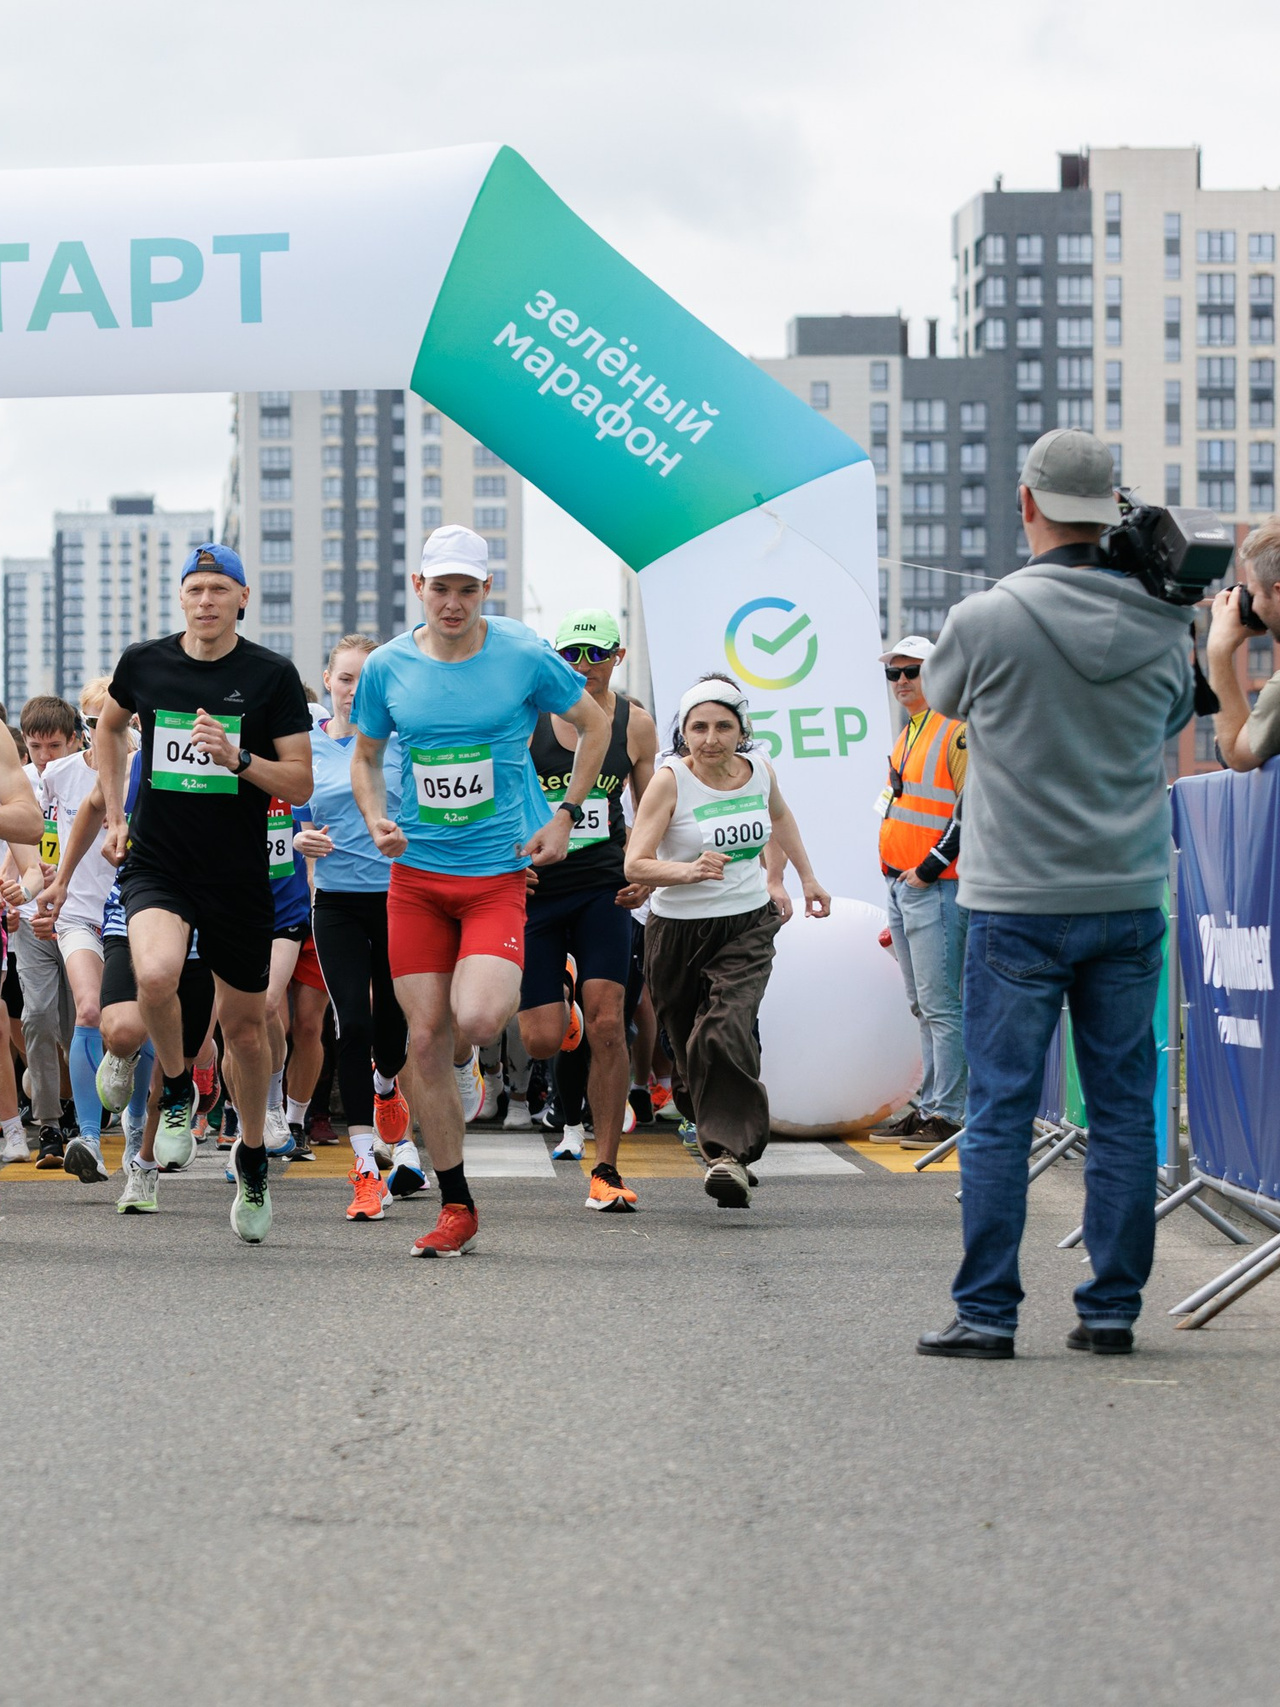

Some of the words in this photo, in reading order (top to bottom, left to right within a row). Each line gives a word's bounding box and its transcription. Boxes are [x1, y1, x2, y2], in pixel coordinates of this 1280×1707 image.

[524, 289, 720, 444] зелёный
[493, 321, 683, 478] марафон
[573, 623, 597, 632] RUN
[747, 706, 868, 760] БЕР
[166, 741, 211, 766] 043
[423, 774, 483, 799] 0564
[596, 774, 620, 794] ull
[573, 810, 600, 830] 25
[714, 821, 764, 847] 0300
